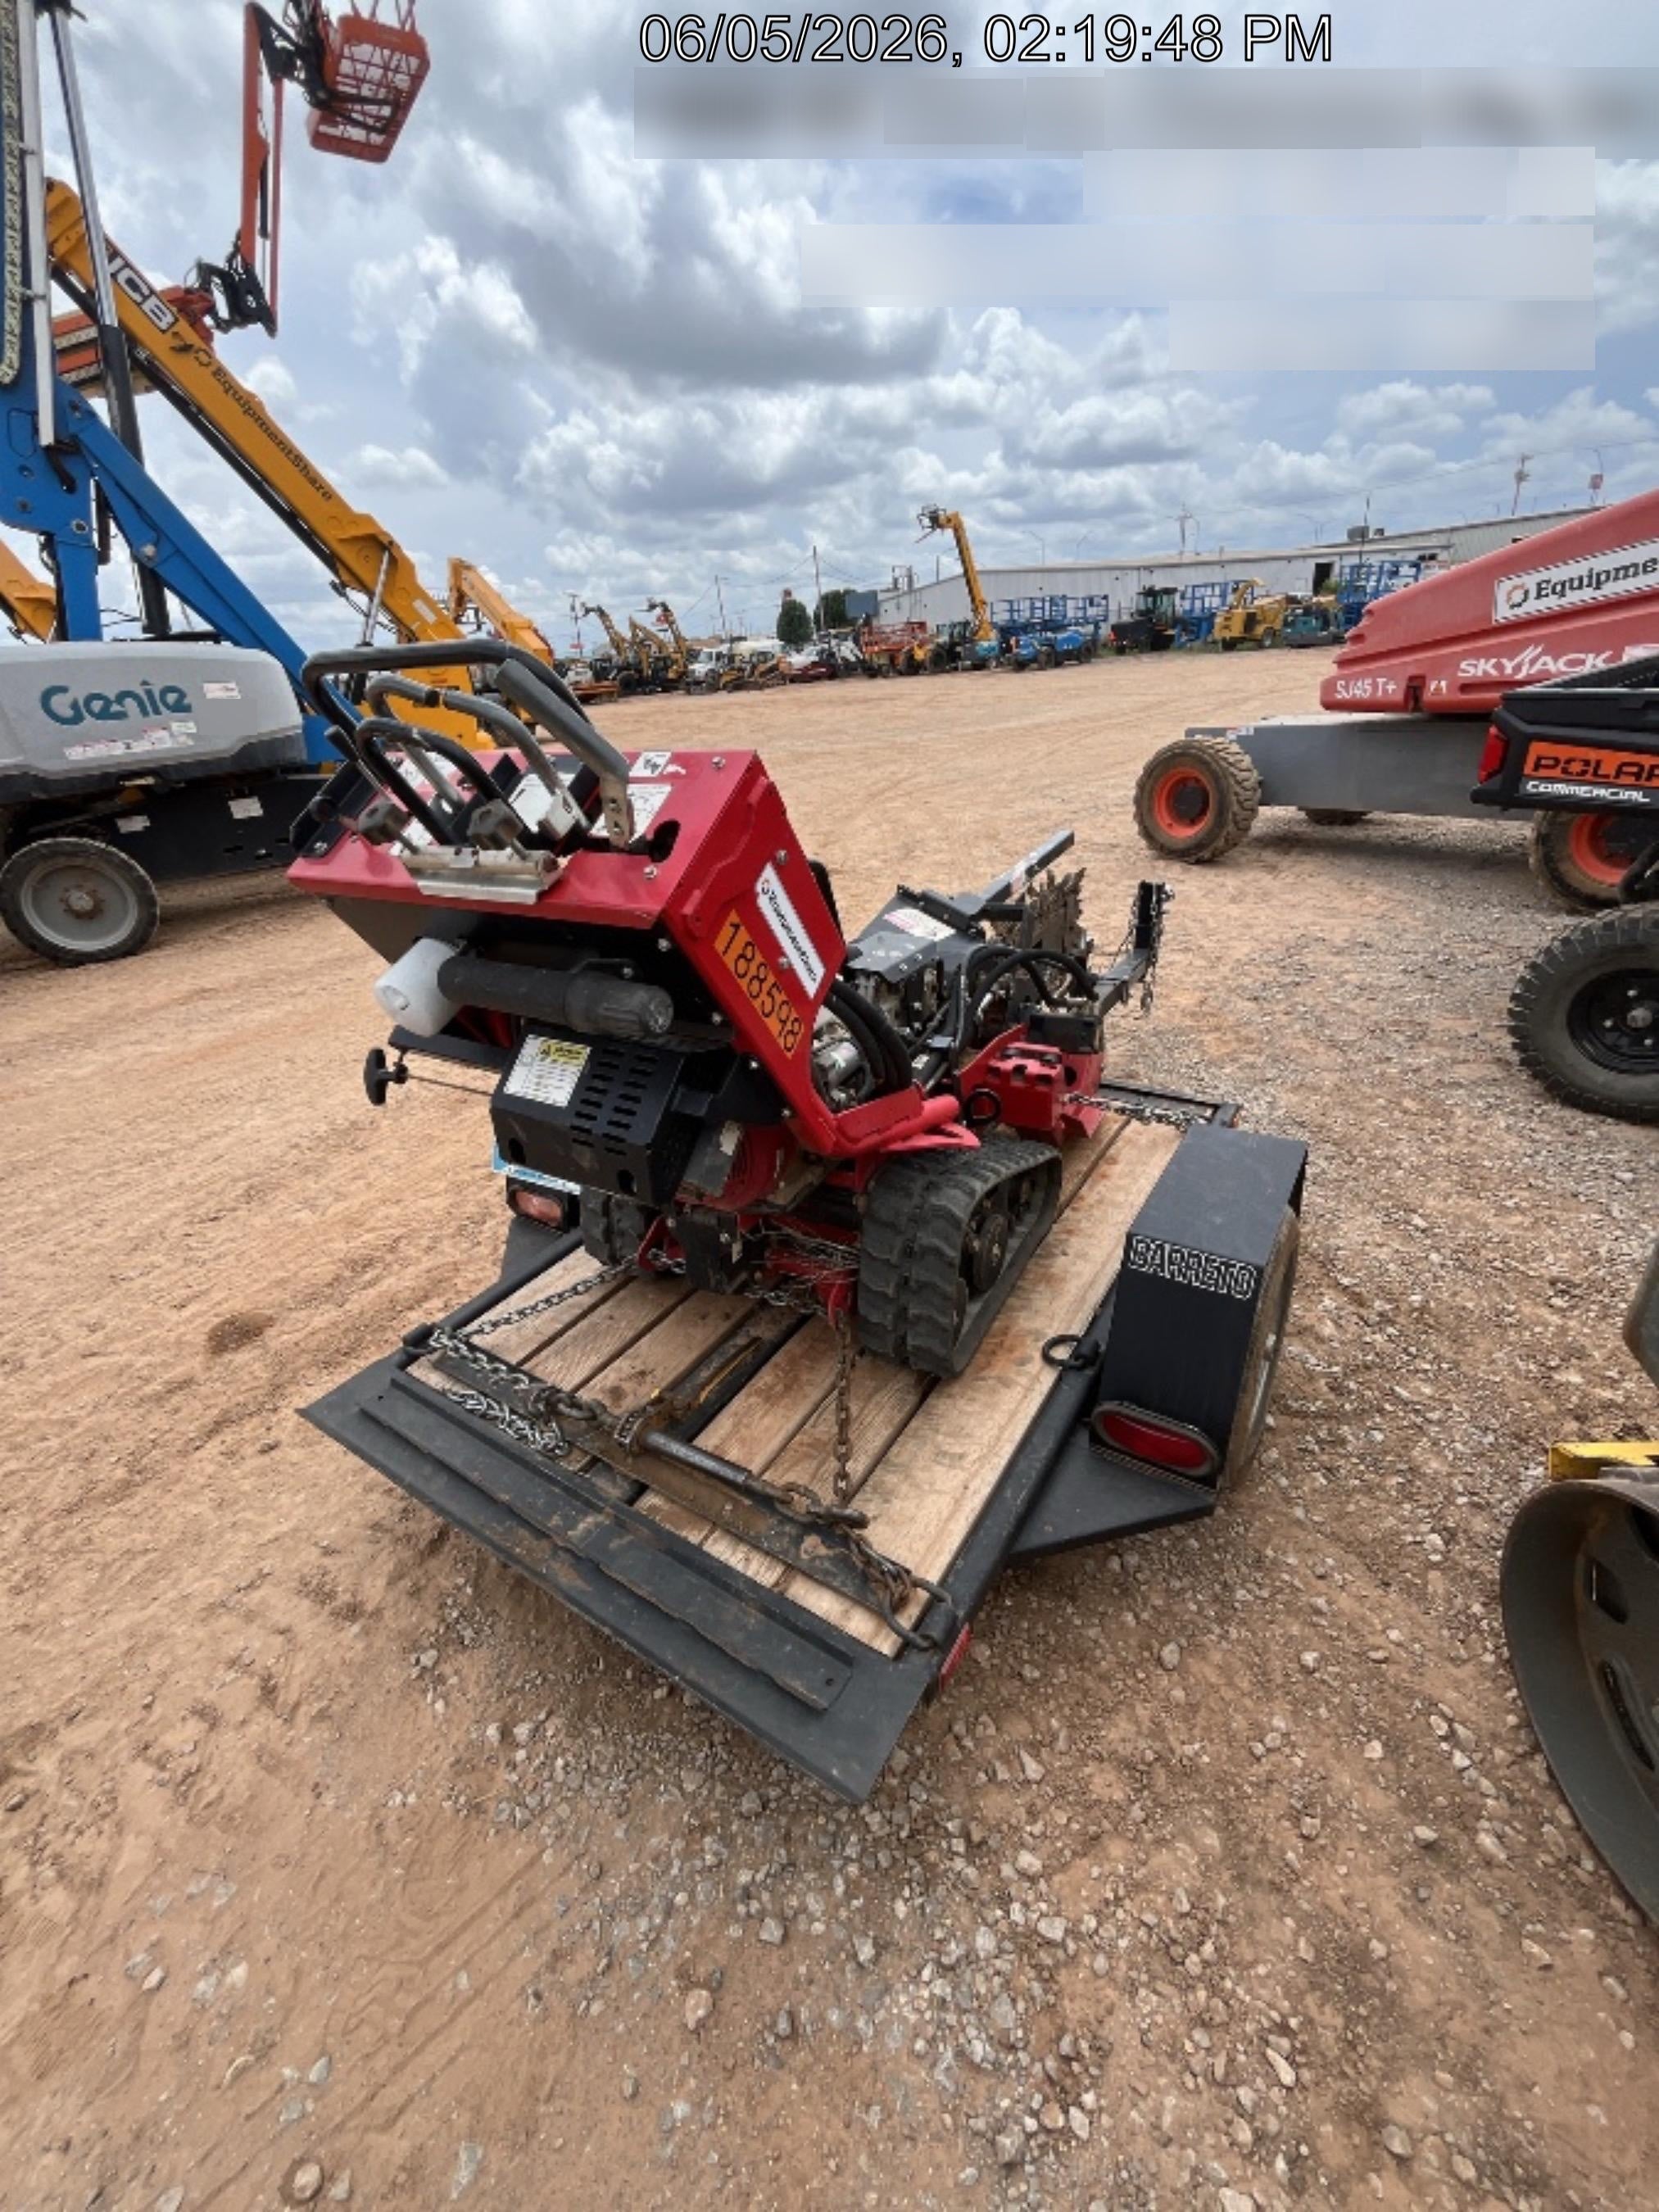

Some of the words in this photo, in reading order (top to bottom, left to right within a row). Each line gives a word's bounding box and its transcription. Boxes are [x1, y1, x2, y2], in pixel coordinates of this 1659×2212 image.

[1457, 643, 1613, 679] SKYJACK
[39, 679, 193, 726] Genie
[1525, 781, 1651, 803] COMMERCIAL
[722, 921, 803, 1053] 188598
[1127, 1235, 1258, 1301] BARRETO
